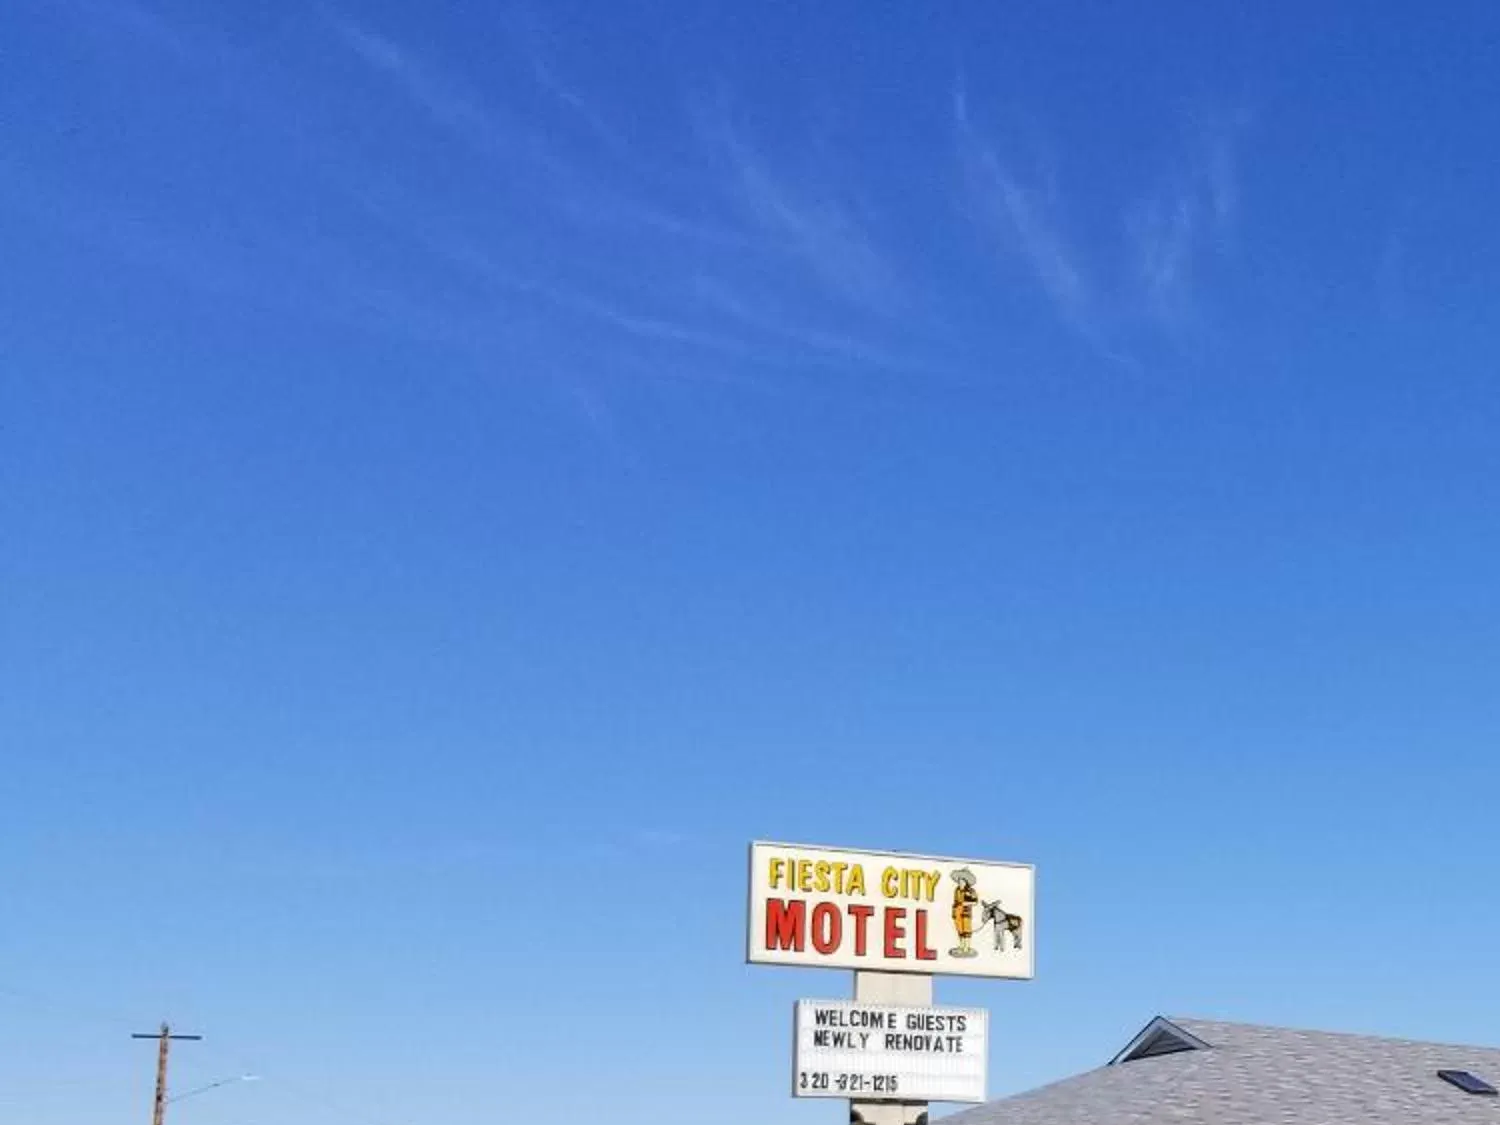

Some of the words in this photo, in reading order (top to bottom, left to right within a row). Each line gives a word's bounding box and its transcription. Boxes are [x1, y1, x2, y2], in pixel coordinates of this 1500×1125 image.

[769, 858, 865, 896] FIESTA
[881, 866, 941, 901] CITY
[766, 898, 937, 960] MOTEL
[815, 1009, 897, 1029] WELCOME
[906, 1015, 967, 1032] GUESTS
[814, 1030, 870, 1049] NEWLY
[885, 1033, 963, 1053] RENOVATE
